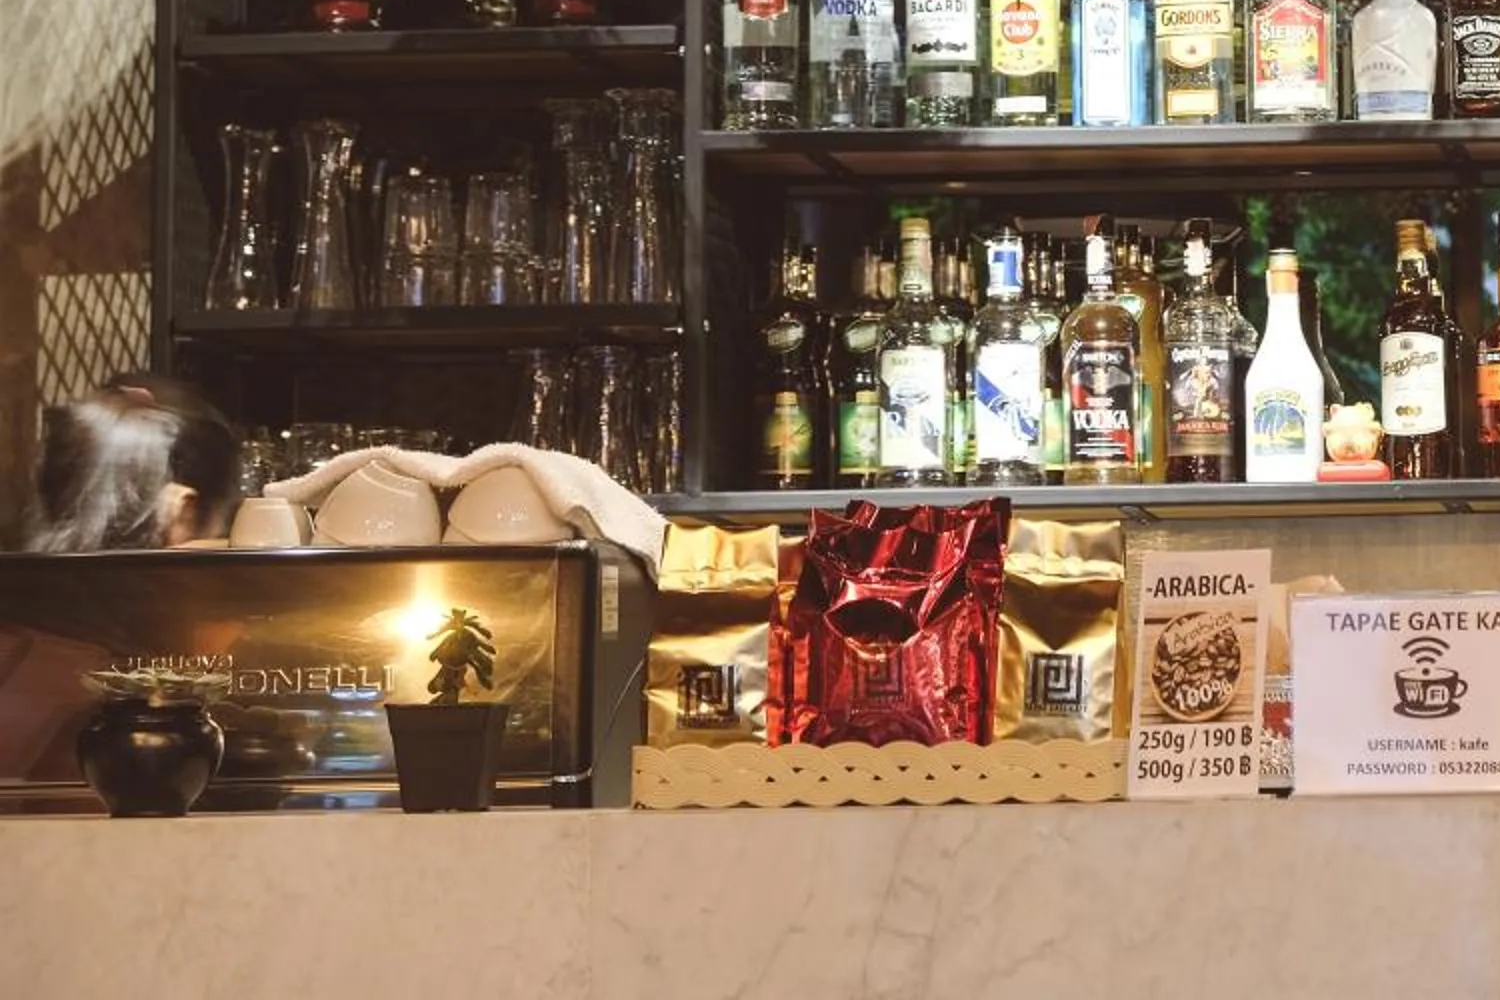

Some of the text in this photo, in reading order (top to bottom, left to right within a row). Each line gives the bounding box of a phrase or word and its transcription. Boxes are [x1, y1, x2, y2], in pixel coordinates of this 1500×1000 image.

[1072, 409, 1129, 431] VODKA
[1327, 611, 1401, 631] TAPAE
[1408, 611, 1469, 631] GATE
[1176, 678, 1234, 711] 100%
[1138, 730, 1185, 753] 250g
[1204, 727, 1236, 748] 190
[1367, 738, 1447, 752] USERNAME
[1459, 737, 1490, 751] kafe
[1137, 759, 1184, 783] 500g
[1199, 756, 1235, 778] 350
[1347, 762, 1427, 775] PASSWORD
